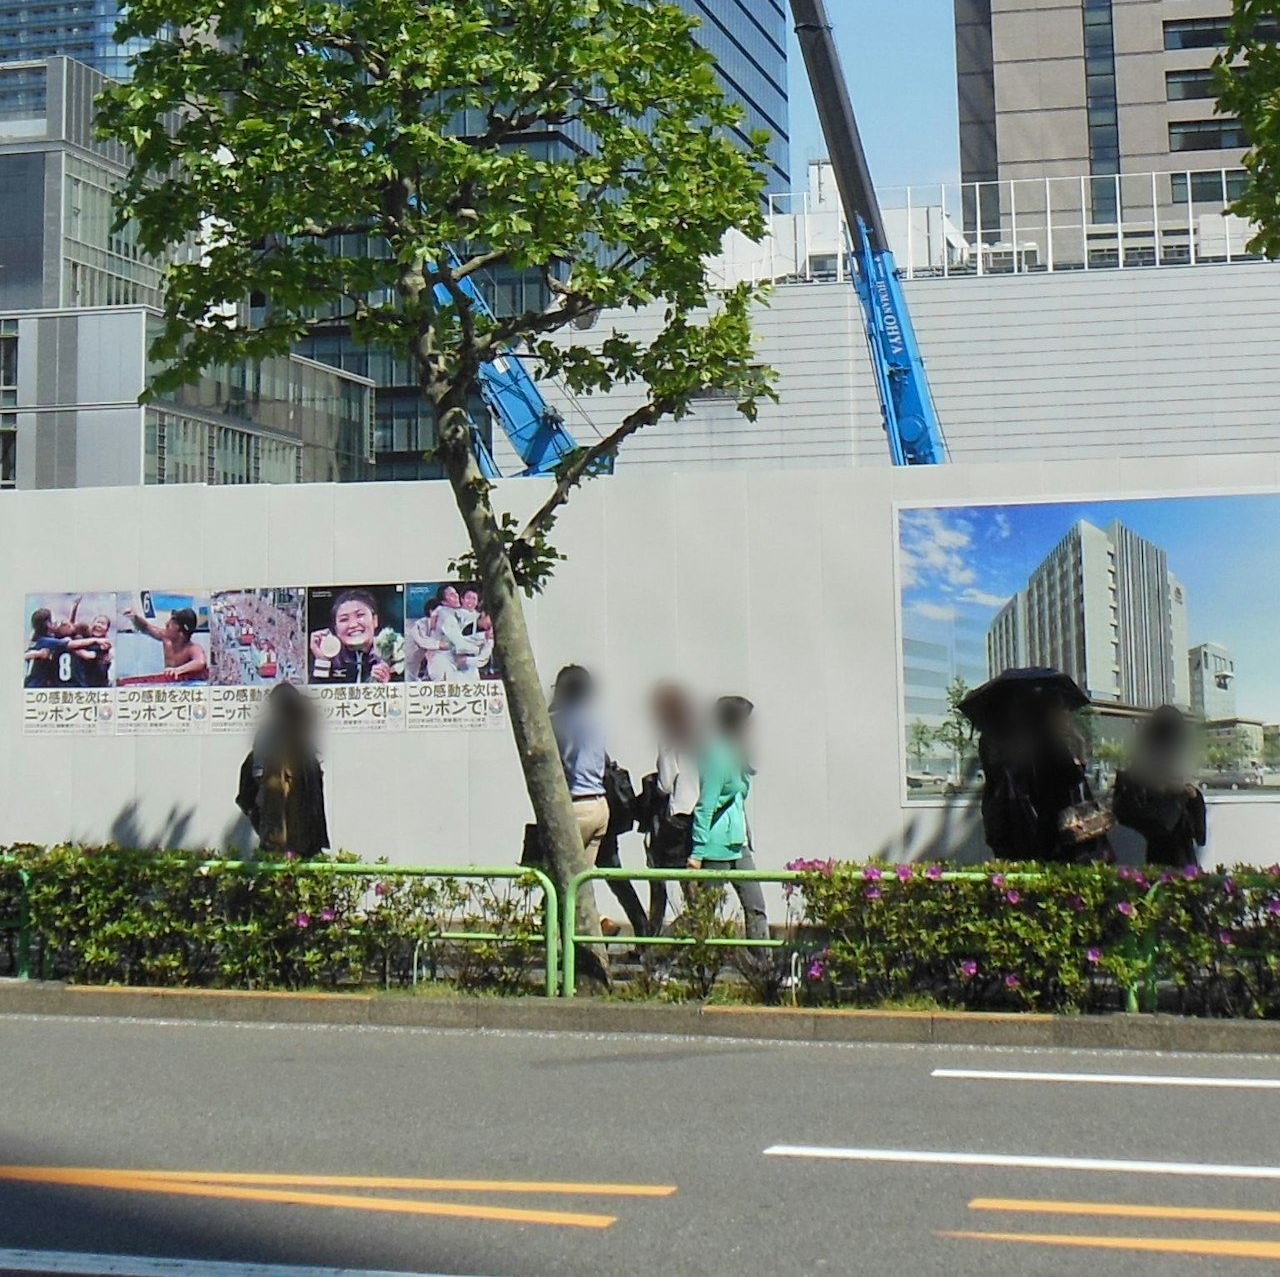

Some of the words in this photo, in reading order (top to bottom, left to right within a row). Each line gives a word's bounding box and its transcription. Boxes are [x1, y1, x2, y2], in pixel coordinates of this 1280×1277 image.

[876, 280, 893, 314] HUMAN
[883, 314, 903, 354] OHYA
[58, 652, 72, 682] 8
[25, 691, 113, 705] この感動を次は、
[118, 689, 207, 703] この感動を次は、
[408, 683, 504, 698] この感動を次は、
[24, 705, 98, 723] ニッポンで!
[117, 704, 192, 722] ニッポンで!
[323, 701, 387, 719] ッポンで!
[408, 698, 488, 717] ニッポンで!
